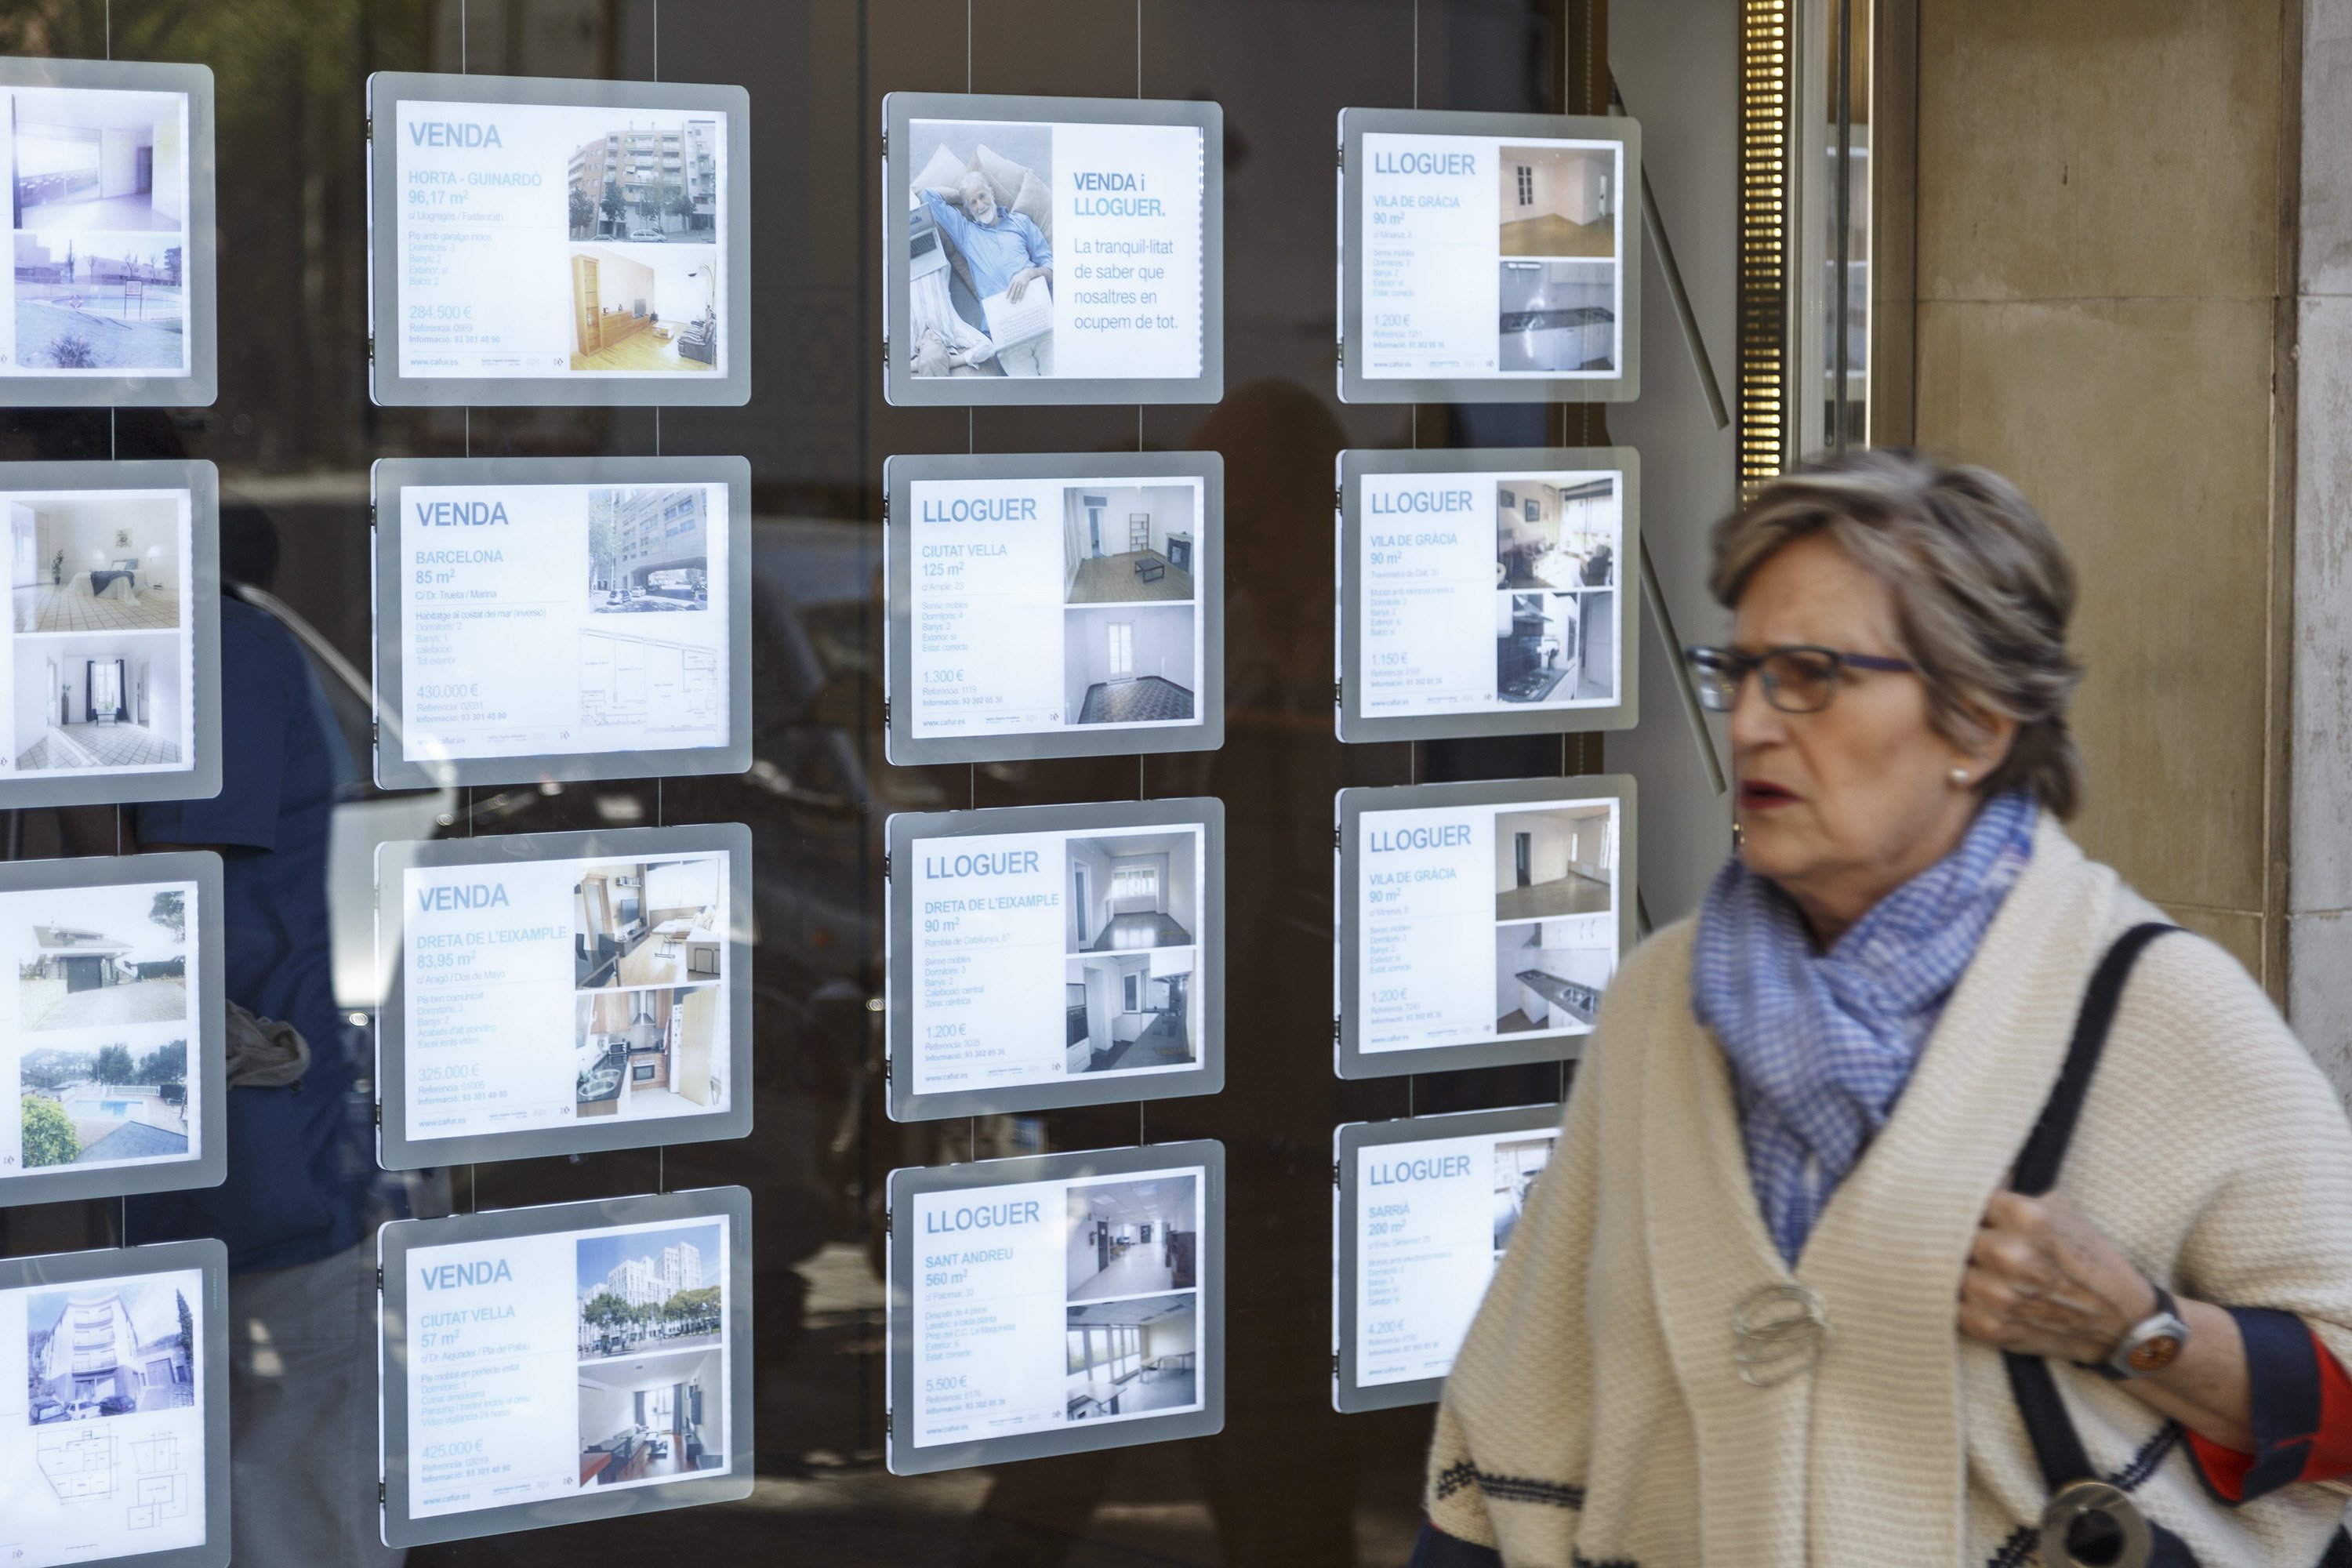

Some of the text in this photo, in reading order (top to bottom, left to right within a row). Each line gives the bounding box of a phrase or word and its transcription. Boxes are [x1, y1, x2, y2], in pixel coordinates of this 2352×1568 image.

[408, 122, 502, 148] VENDA
[1375, 152, 1475, 175] LLOGUER
[409, 172, 542, 187] HORTA GUINARDÓ
[1074, 172, 1144, 191] VENDA i
[409, 191, 445, 205] 96,17
[1374, 196, 1398, 207] VILA
[1401, 196, 1415, 207] DE
[1075, 198, 1166, 216] LLOGUER.
[1374, 212, 1386, 223] 90
[1075, 238, 1173, 257] La tranquil·litat
[409, 255, 434, 263] Banys:
[1075, 264, 1164, 281] de saber que
[1075, 290, 1156, 303] nosaltres en
[410, 306, 472, 318] 284.500 €
[1075, 315, 1178, 332] ocupem de tot.
[1375, 314, 1410, 326] 1.200 €
[1373, 491, 1472, 514] LLOGUER
[416, 502, 509, 526] VENDA
[924, 499, 1036, 522] LLOGUER
[1371, 535, 1395, 546] VILA
[1399, 535, 1412, 546] DE
[416, 550, 503, 564] BARCELONA
[922, 544, 1007, 557] CIUTAT VELLA
[1371, 553, 1384, 564] 90
[923, 563, 944, 576] 125
[416, 571, 432, 583] 85
[441, 590, 464, 599] Trueta
[470, 590, 496, 598] Marina
[416, 612, 450, 621] Habitatge
[461, 610, 483, 619] costat
[1373, 652, 1408, 665] 1.150 €
[924, 670, 964, 683] 1.300 €
[417, 684, 478, 698] 430.000 €
[1371, 825, 1472, 852] LLOGUER
[927, 851, 1039, 879] LLOGUER
[1370, 873, 1394, 885] VILA
[1397, 872, 1411, 883] DE
[418, 884, 510, 912] VENDA
[925, 894, 1058, 913] DRETA DE L'EIXAMPLE
[1370, 891, 1382, 902] 90
[925, 920, 939, 932] 90
[417, 927, 567, 949] DRETA DE L'EIXAMPLE
[417, 954, 453, 969] 83,95
[948, 955, 971, 964] mobles
[456, 972, 471, 982] Dos
[473, 971, 482, 980] de
[484, 971, 505, 981] Mayo
[418, 993, 484, 1004] Pis ben comunicat
[1373, 988, 1407, 1002] 1.200 €
[927, 1023, 967, 1038] 1.200 €
[419, 1063, 480, 1081] 325.000 €
[419, 1117, 466, 1127] www.cafur.es
[1370, 1155, 1470, 1185] LLOGUER
[927, 1201, 1040, 1233] LLOGUER
[1369, 1223, 1388, 1235] 200
[926, 1248, 1013, 1268] SANT ANDREU
[421, 1259, 512, 1291] VENDA
[926, 1272, 947, 1286] 560
[421, 1305, 515, 1328] CIUTAT VELLA
[422, 1334, 437, 1347] 57
[927, 1375, 967, 1392] 5.500 €
[423, 1439, 483, 1458] 425.000 €
